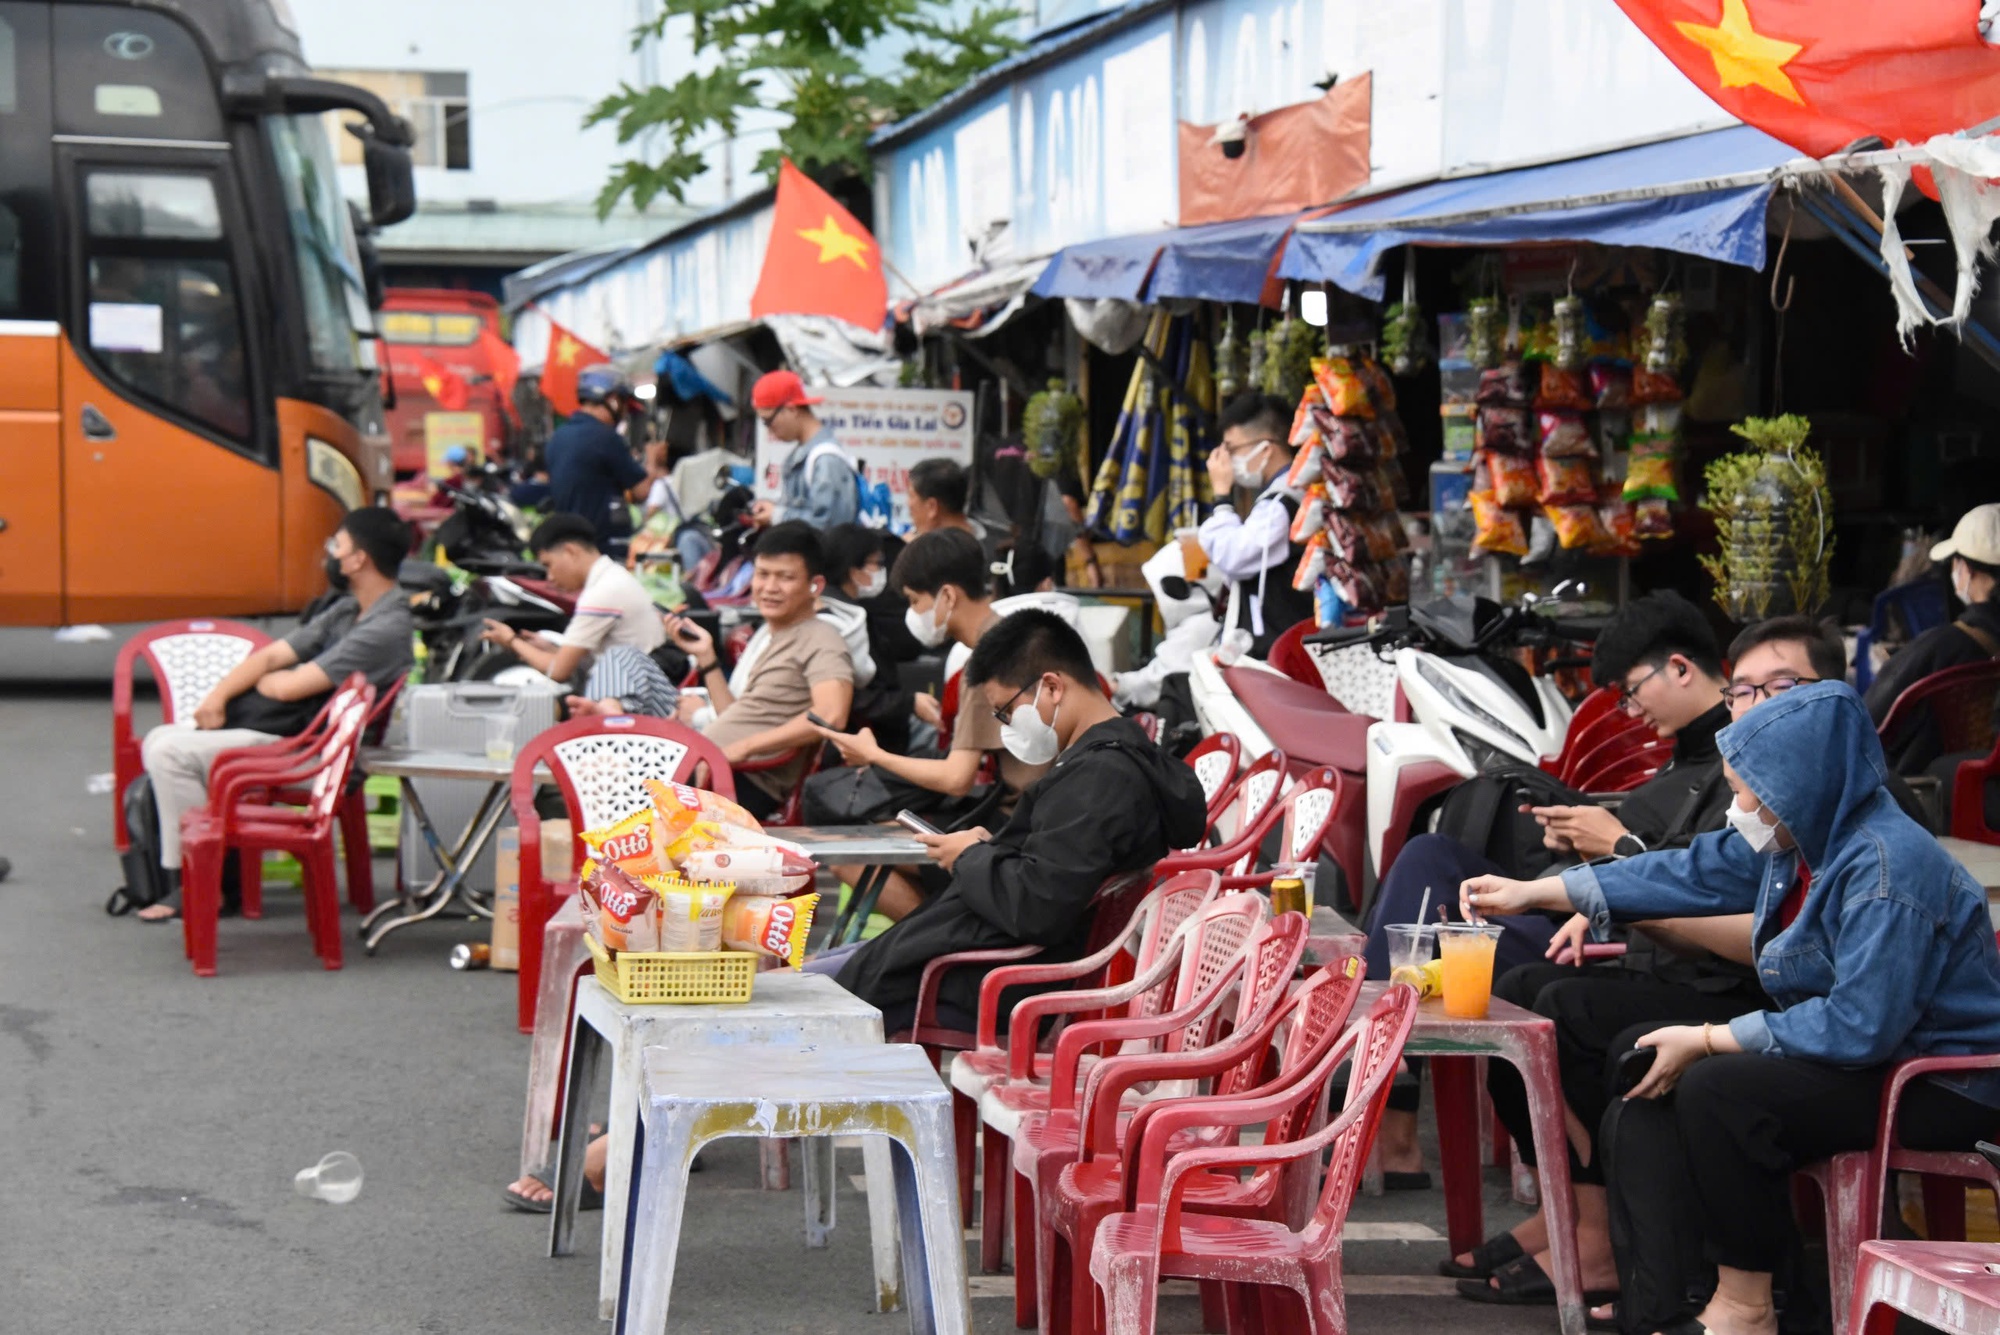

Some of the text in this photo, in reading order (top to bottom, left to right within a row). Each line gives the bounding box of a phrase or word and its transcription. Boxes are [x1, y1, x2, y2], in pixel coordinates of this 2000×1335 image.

[852, 412, 883, 429] Tiến
[887, 414, 911, 431] Gia
[914, 415, 938, 432] Lai
[604, 834, 649, 861] Otto
[600, 882, 629, 917] Otto
[766, 904, 794, 950] Otto
